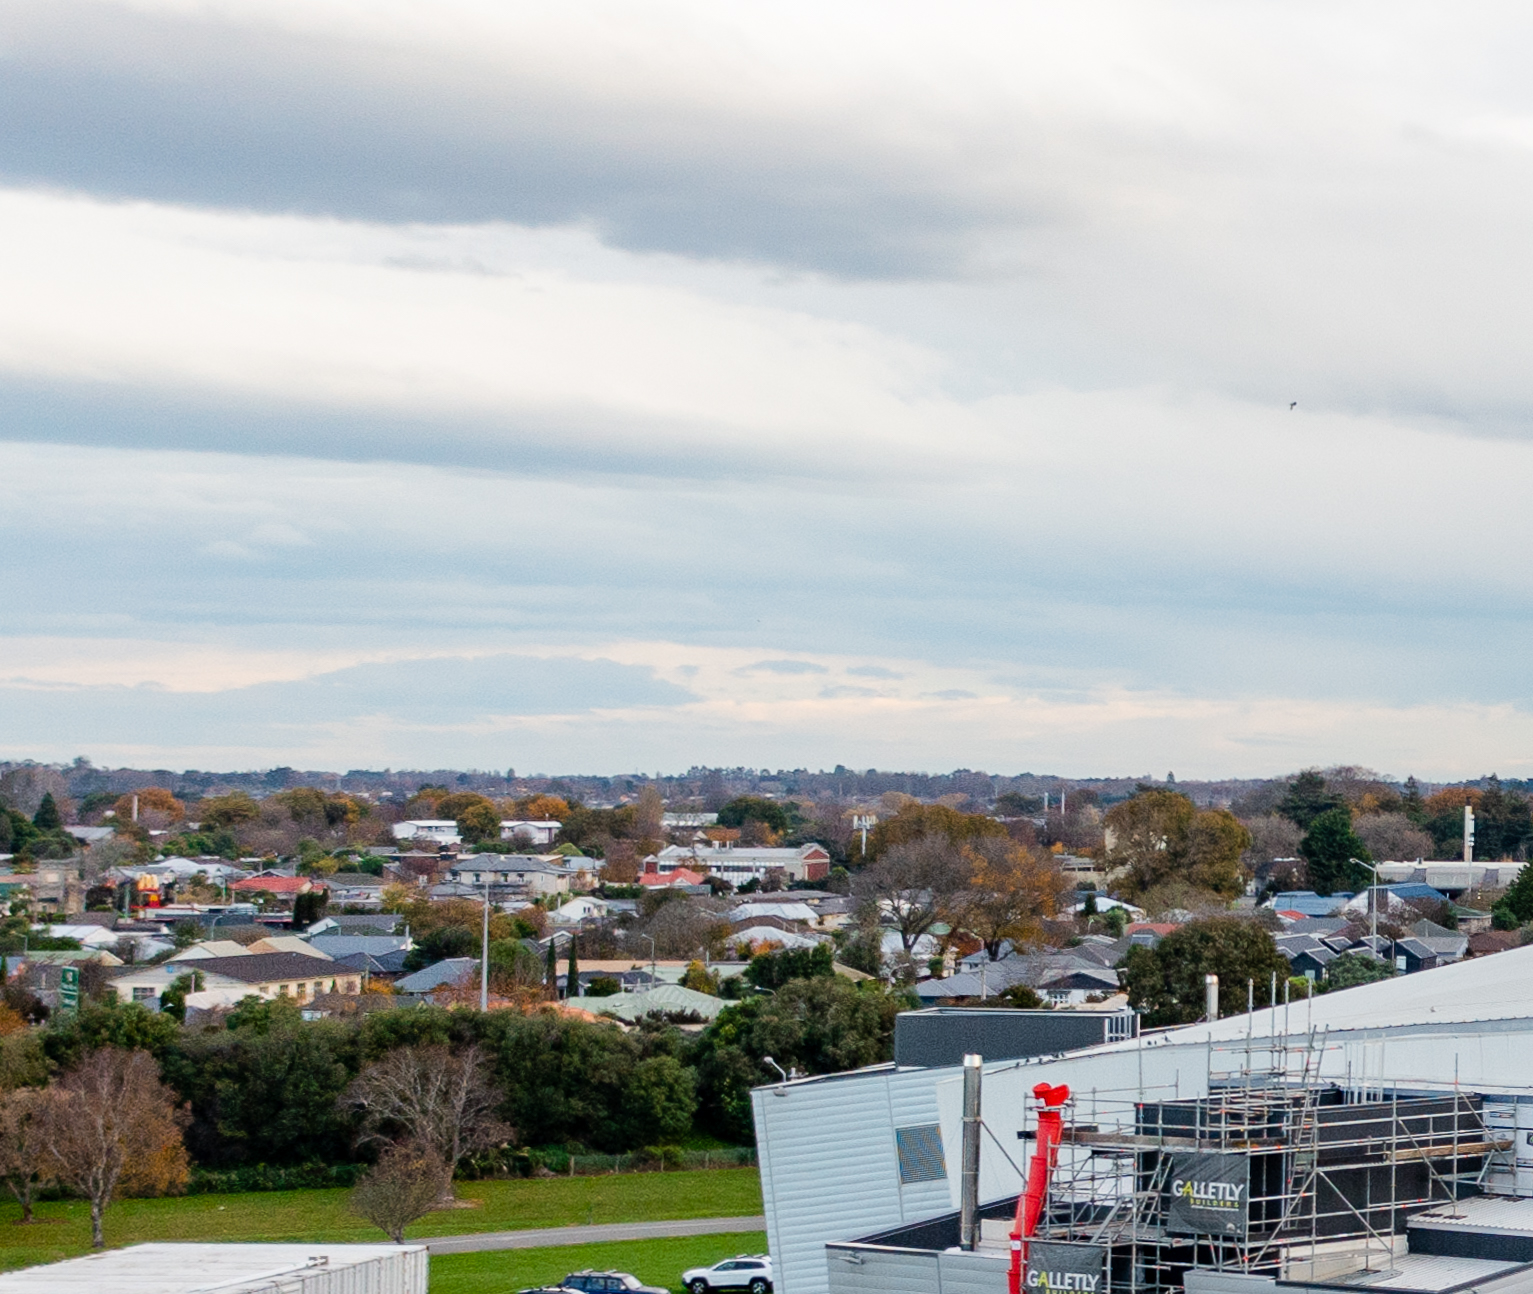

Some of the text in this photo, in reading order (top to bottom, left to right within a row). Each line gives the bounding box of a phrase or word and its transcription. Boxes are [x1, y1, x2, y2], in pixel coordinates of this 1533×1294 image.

[1172, 1179, 1245, 1201] GALLETLY
[1189, 1197, 1240, 1208] BUILDERS
[1026, 1269, 1101, 1291] GALLETLY
